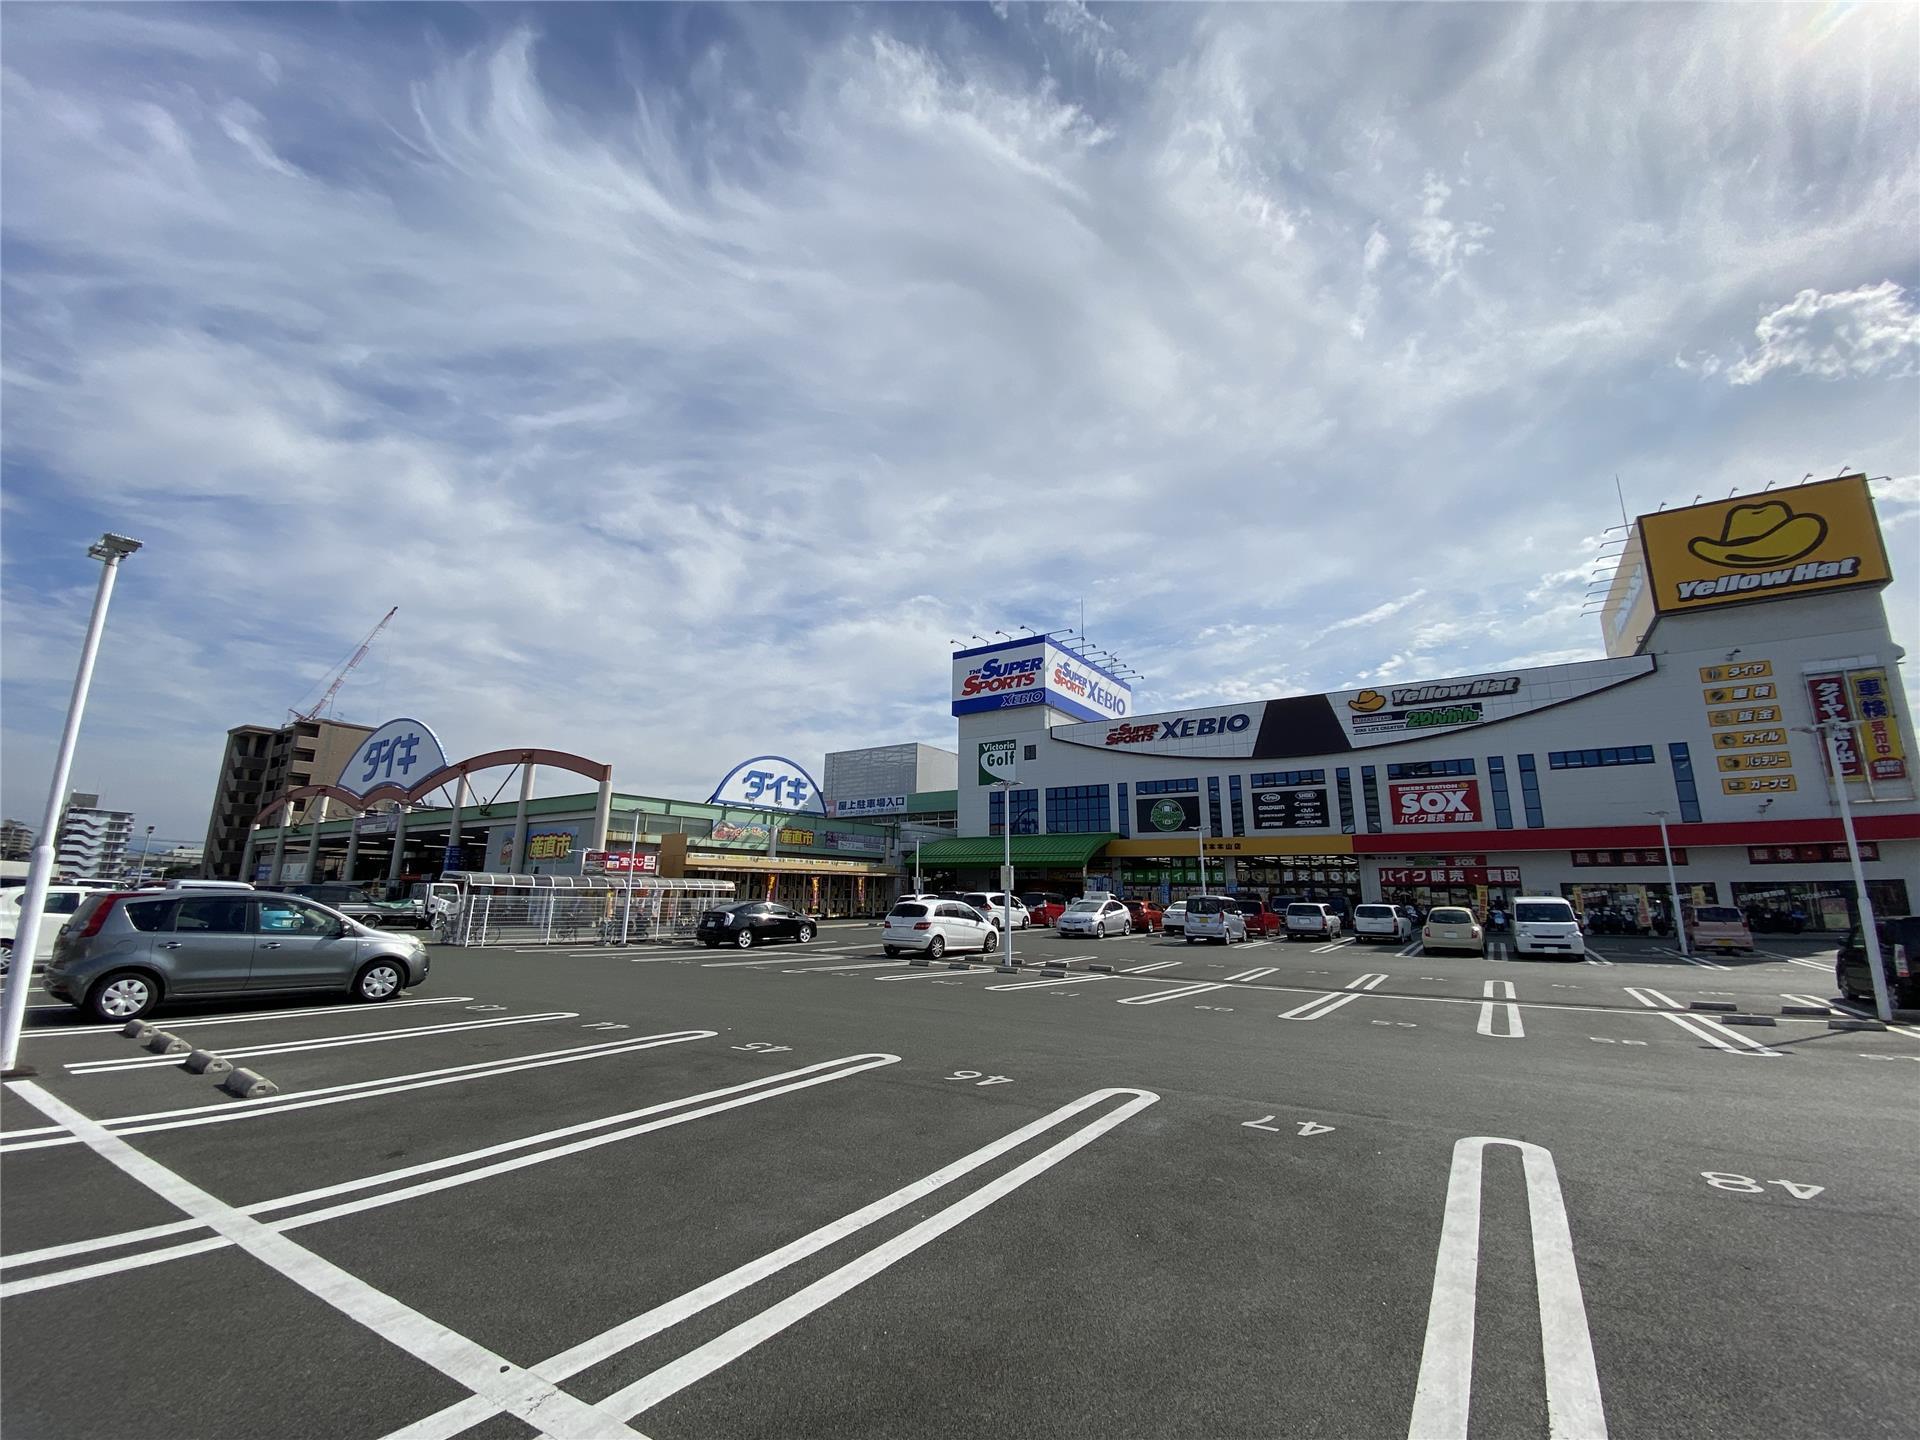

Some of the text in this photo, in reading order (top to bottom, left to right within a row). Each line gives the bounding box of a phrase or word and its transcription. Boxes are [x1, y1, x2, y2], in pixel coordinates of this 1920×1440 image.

[968, 657, 1043, 680] THE SUPER
[1062, 662, 1088, 689] SUPER
[1727, 664, 1766, 676] タイヤ
[962, 672, 1036, 696] SPORTS
[1053, 668, 1085, 698] SPORTS
[1001, 690, 1043, 707] XEBIO
[1087, 677, 1127, 716] XEBIO
[1731, 685, 1771, 699] 車検
[1105, 713, 1251, 746] SPORTS XEBIO
[1118, 723, 1159, 737] SUPER
[1743, 731, 1779, 744] オイル
[982, 742, 1015, 751] Victoria
[362, 732, 420, 783] ダイキ
[987, 750, 1015, 767] Golf
[1745, 756, 1786, 767] バッテリー
[742, 769, 808, 806] ダイキ
[1750, 778, 1791, 790] カーナビ
[838, 797, 905, 810] 屋上駐車場入口
[1401, 790, 1471, 814] SOX
[1400, 812, 1475, 824] バイク販売・買取
[779, 827, 815, 846] 産直市
[529, 833, 573, 860] 産直市
[620, 857, 645, 867] 宝くじ
[1454, 858, 1477, 866] SOX
[1381, 869, 1521, 884] バイク販売・買取
[731, 1041, 793, 1054] 45
[944, 1070, 1014, 1086] 46
[1241, 1115, 1336, 1137] 47
[1700, 1171, 1826, 1200] 48
